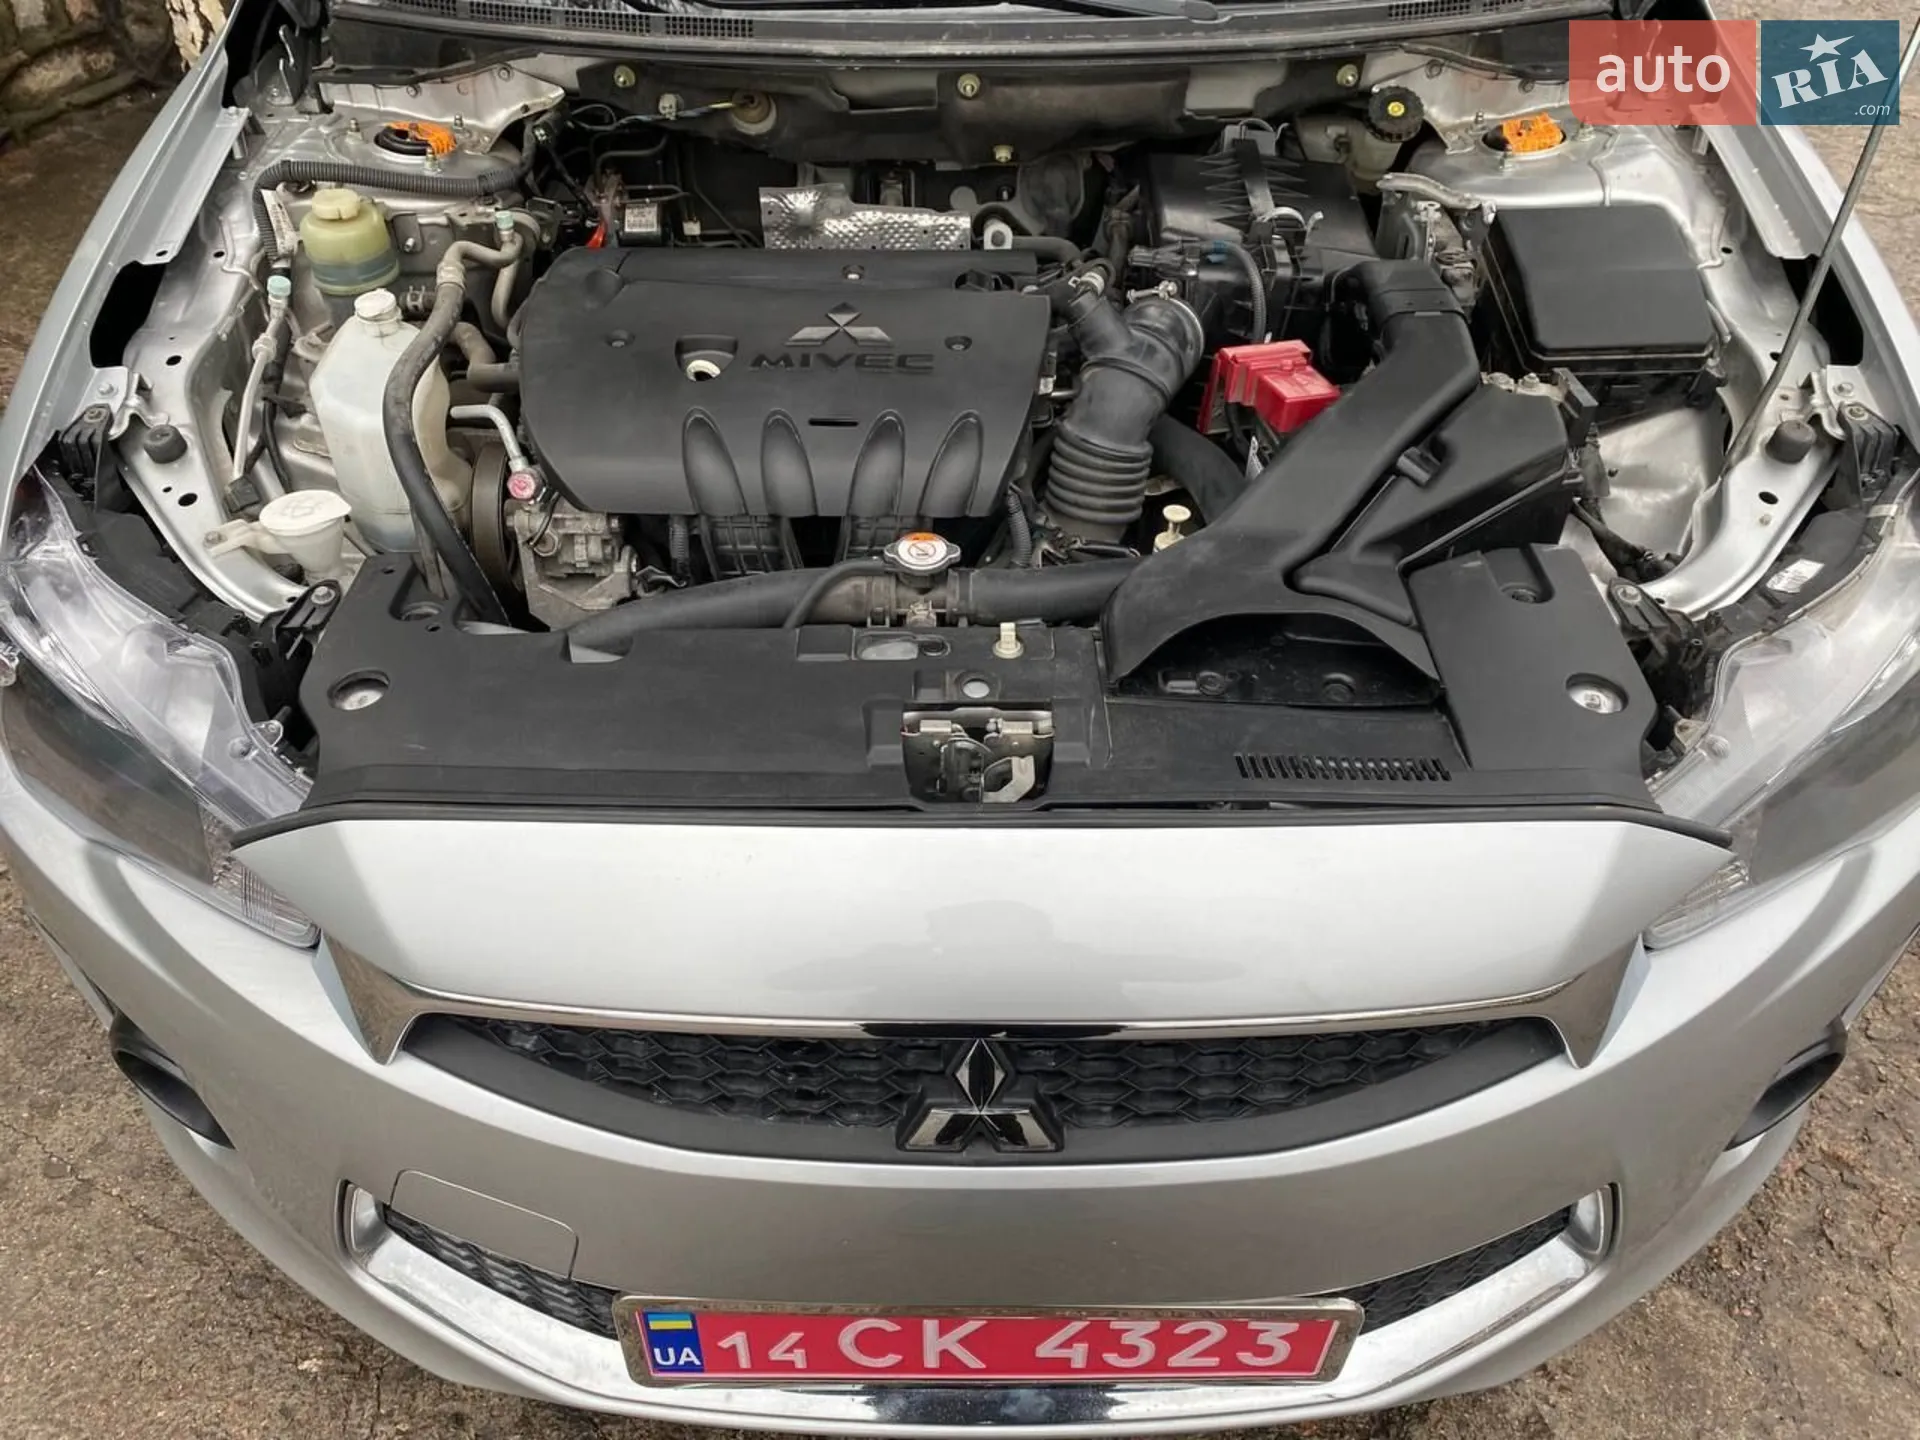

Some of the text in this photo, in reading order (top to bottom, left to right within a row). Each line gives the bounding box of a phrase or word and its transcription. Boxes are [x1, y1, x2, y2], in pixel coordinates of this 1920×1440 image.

[749, 352, 935, 374] MIVEC
[717, 1318, 1300, 1369] 14 CK 4323
[653, 1346, 702, 1366] UA
